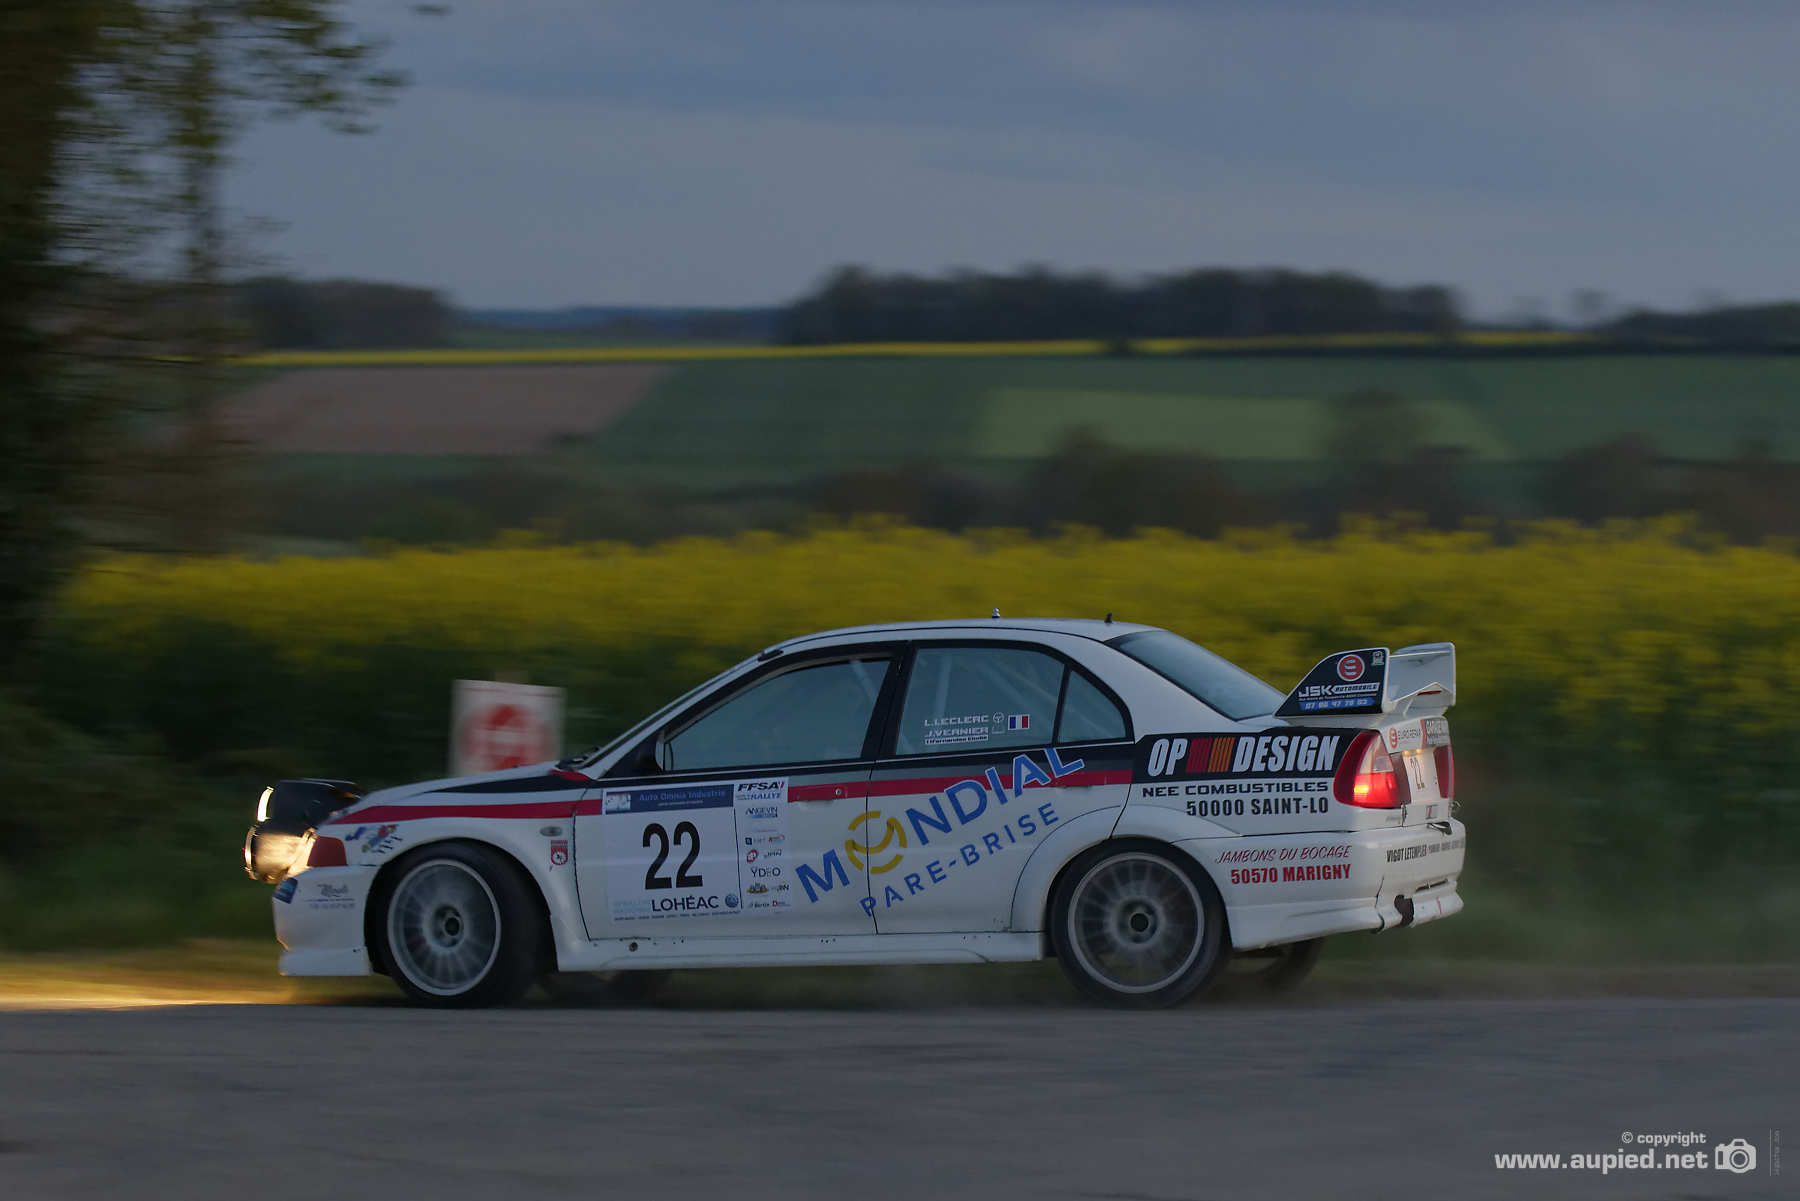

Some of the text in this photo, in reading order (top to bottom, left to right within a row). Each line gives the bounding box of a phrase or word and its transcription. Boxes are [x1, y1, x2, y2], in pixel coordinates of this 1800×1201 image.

[1298, 684, 1332, 698] JSK
[1335, 683, 1378, 693] AUTOMOBILE
[924, 714, 989, 727] L.LECLERC
[924, 726, 989, 738] J.VERNIER
[1147, 735, 1340, 777] OP DESIGN
[738, 781, 779, 792] FFSA
[1142, 781, 1329, 798] NEE COMBUSTIBLES
[1186, 796, 1329, 818] 50000 SAINT-LO
[642, 820, 704, 890] 22
[859, 802, 1060, 918] PARE-BRISE
[1215, 845, 1353, 865] JAMBONS DU BOCAGE
[1231, 863, 1352, 885] 50570 MARIGNY
[651, 895, 720, 912] LOHÉAC
